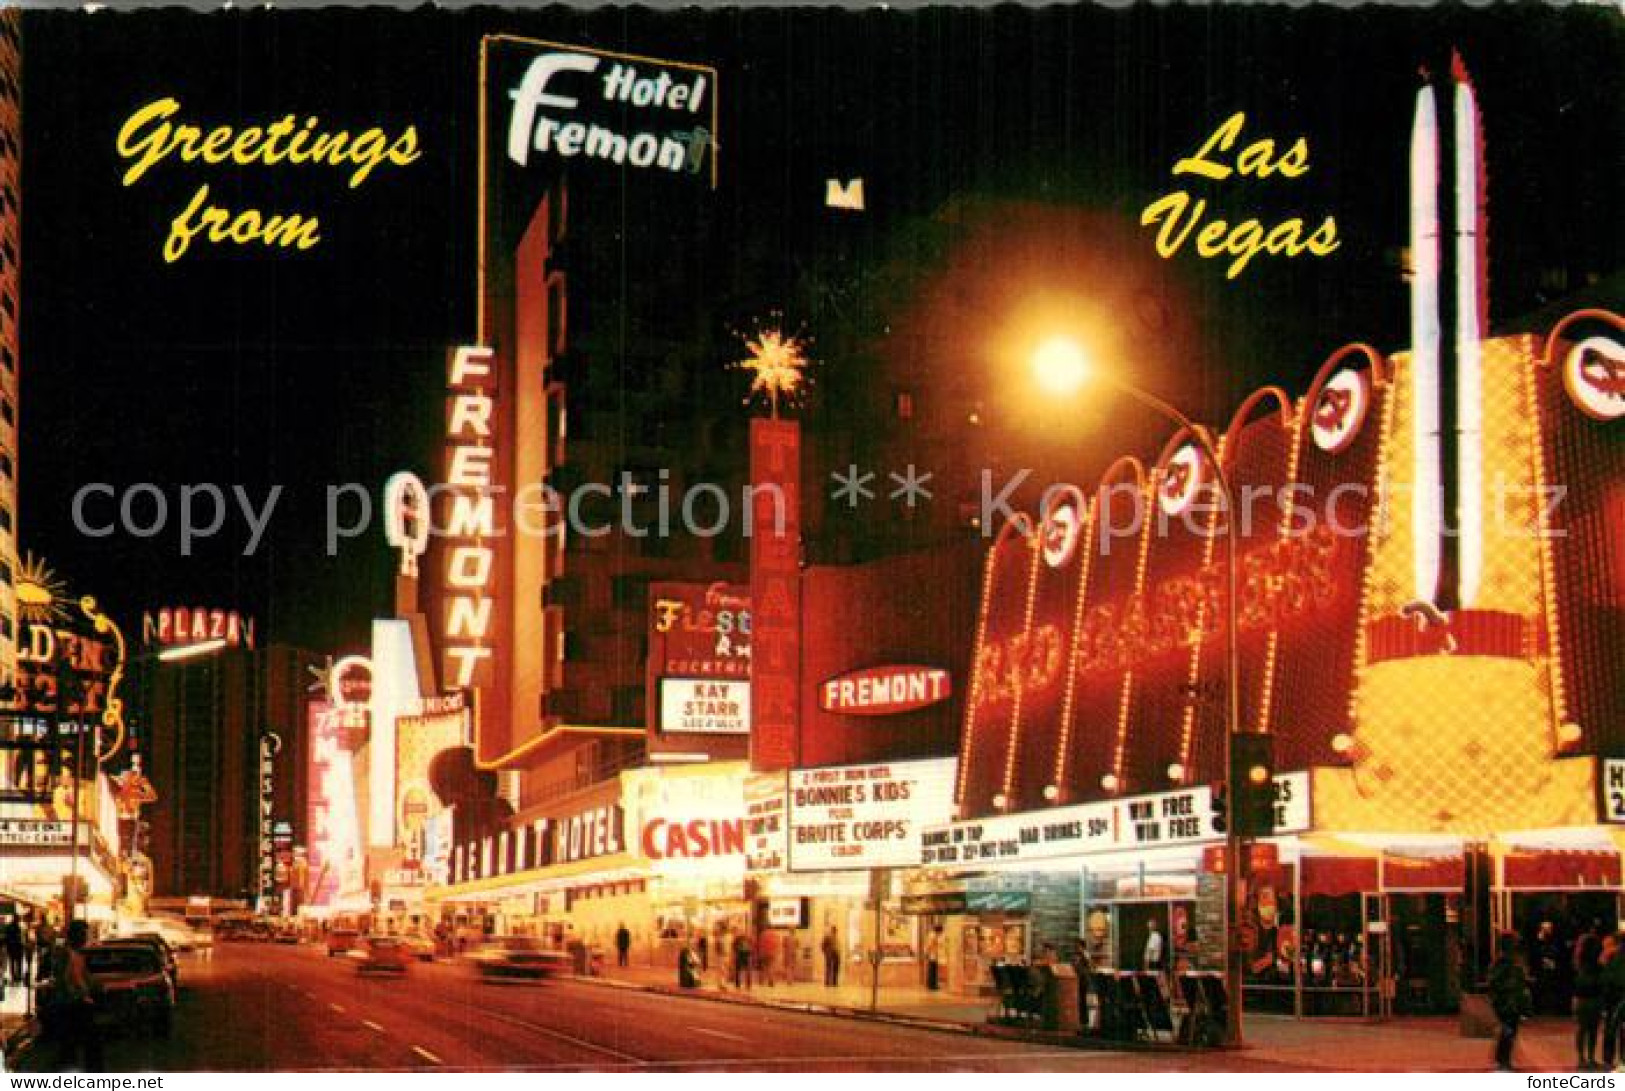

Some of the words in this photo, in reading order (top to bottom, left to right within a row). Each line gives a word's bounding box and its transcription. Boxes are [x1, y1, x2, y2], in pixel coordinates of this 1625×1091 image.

[602, 64, 706, 114] Hotel
[508, 52, 718, 173] Fremont
[447, 346, 495, 687] FREMONT
[157, 608, 240, 645] PLAZA
[684, 701, 738, 715] STARR
[824, 670, 946, 710] FREMONT
[1129, 801, 1153, 821] WIN
[1162, 794, 1193, 818] FREE
[642, 817, 746, 861] CASIN
[796, 821, 846, 844] BRUTE
[1167, 817, 1201, 840] FREE
